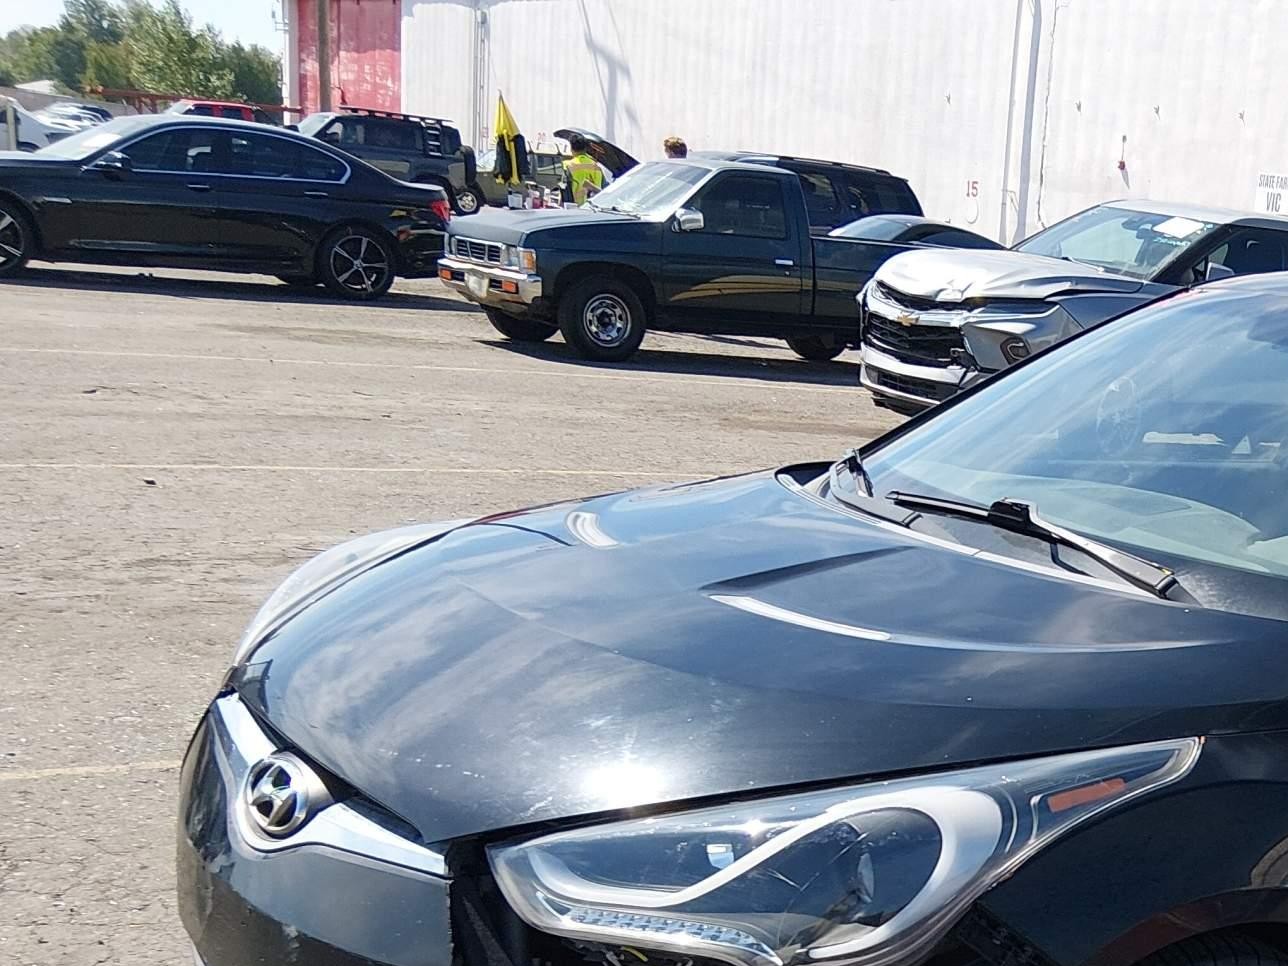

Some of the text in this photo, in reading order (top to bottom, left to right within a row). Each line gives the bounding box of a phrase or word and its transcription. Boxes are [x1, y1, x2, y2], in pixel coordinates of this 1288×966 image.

[966, 180, 979, 197] 15
[1259, 174, 1276, 189] STATE
[1266, 191, 1282, 212] VIC
